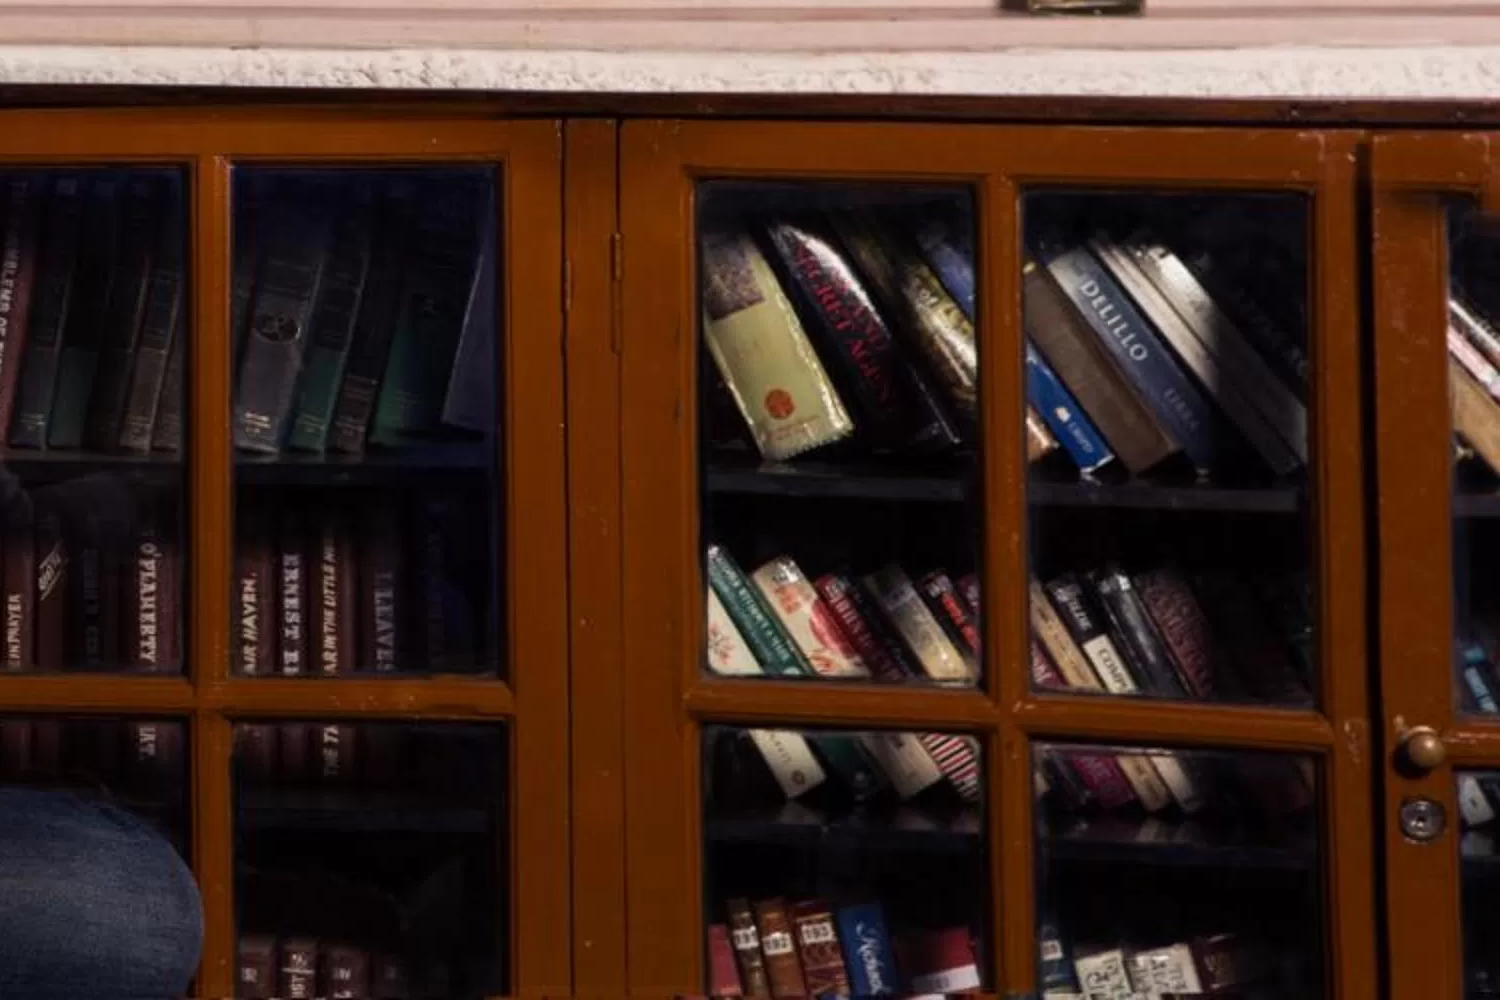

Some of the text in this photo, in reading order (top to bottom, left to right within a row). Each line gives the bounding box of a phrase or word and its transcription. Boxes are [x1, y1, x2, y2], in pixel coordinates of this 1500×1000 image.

[1080, 279, 1150, 365] DELILLO
[138, 543, 162, 662] O'FLAHERTY
[282, 553, 301, 639] ERNEST
[320, 566, 337, 608] LITTLE
[6, 594, 21, 643] PRAYER
[323, 609, 337, 633] THE
[243, 645, 258, 674] AIR
